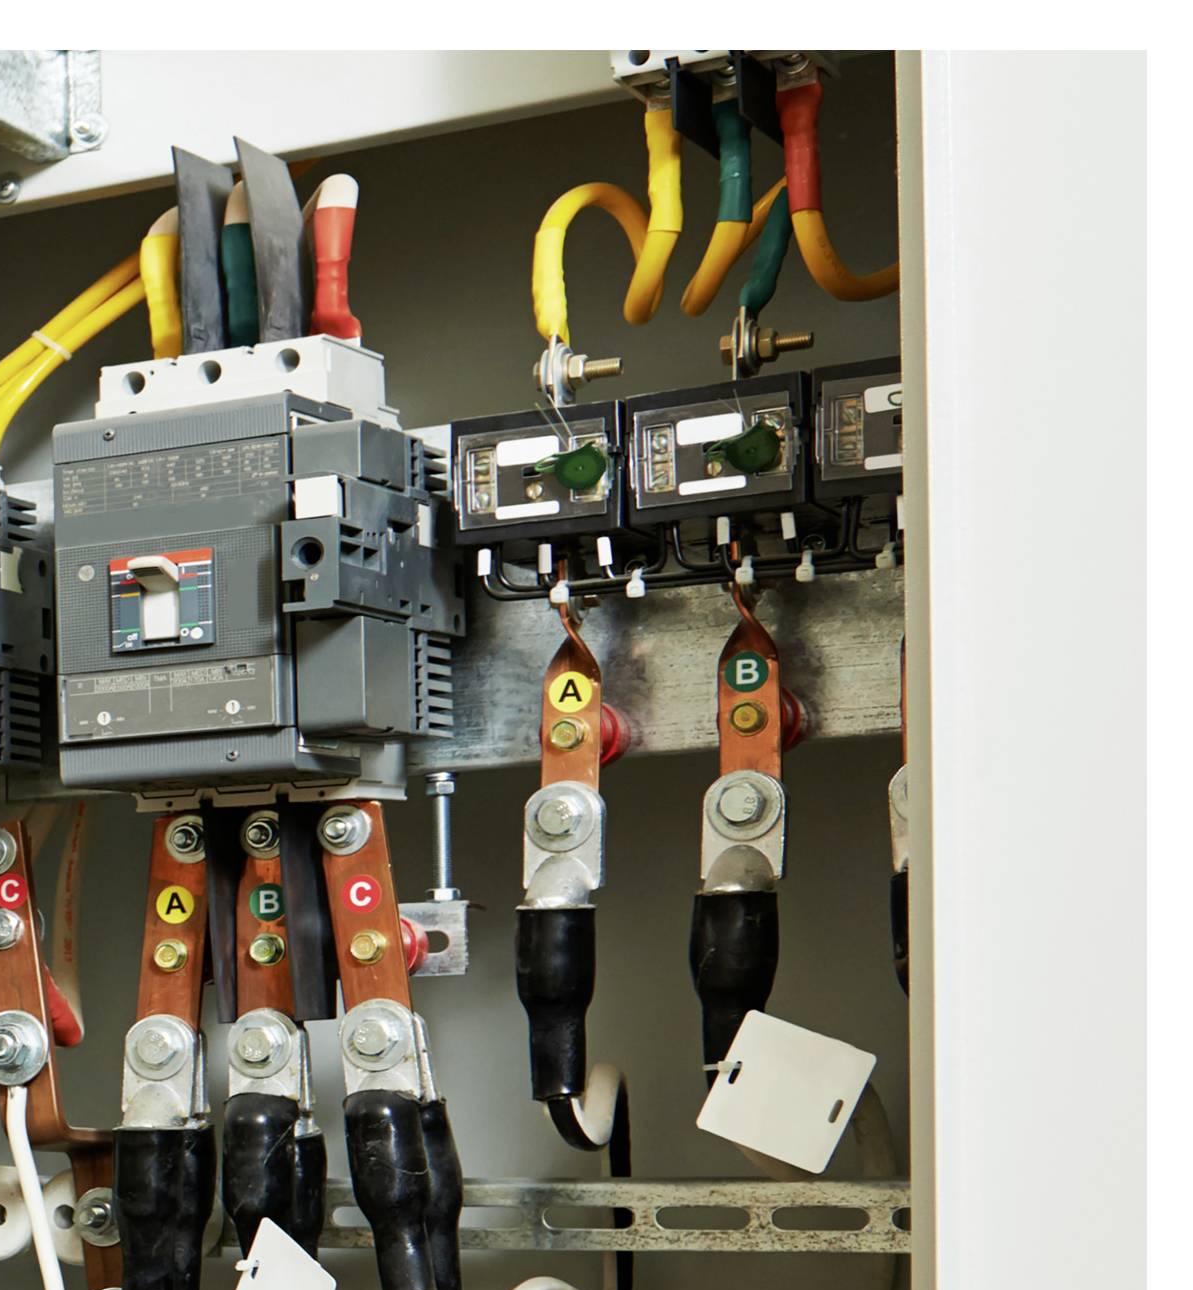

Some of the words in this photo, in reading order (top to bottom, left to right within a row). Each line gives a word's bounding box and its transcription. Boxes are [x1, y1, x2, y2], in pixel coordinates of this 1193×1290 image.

[735, 658, 760, 685] B
[558, 679, 583, 703] A
[0, 878, 21, 902] C
[259, 890, 280, 914] B
[349, 881, 372, 907] C
[165, 892, 187, 915] A
